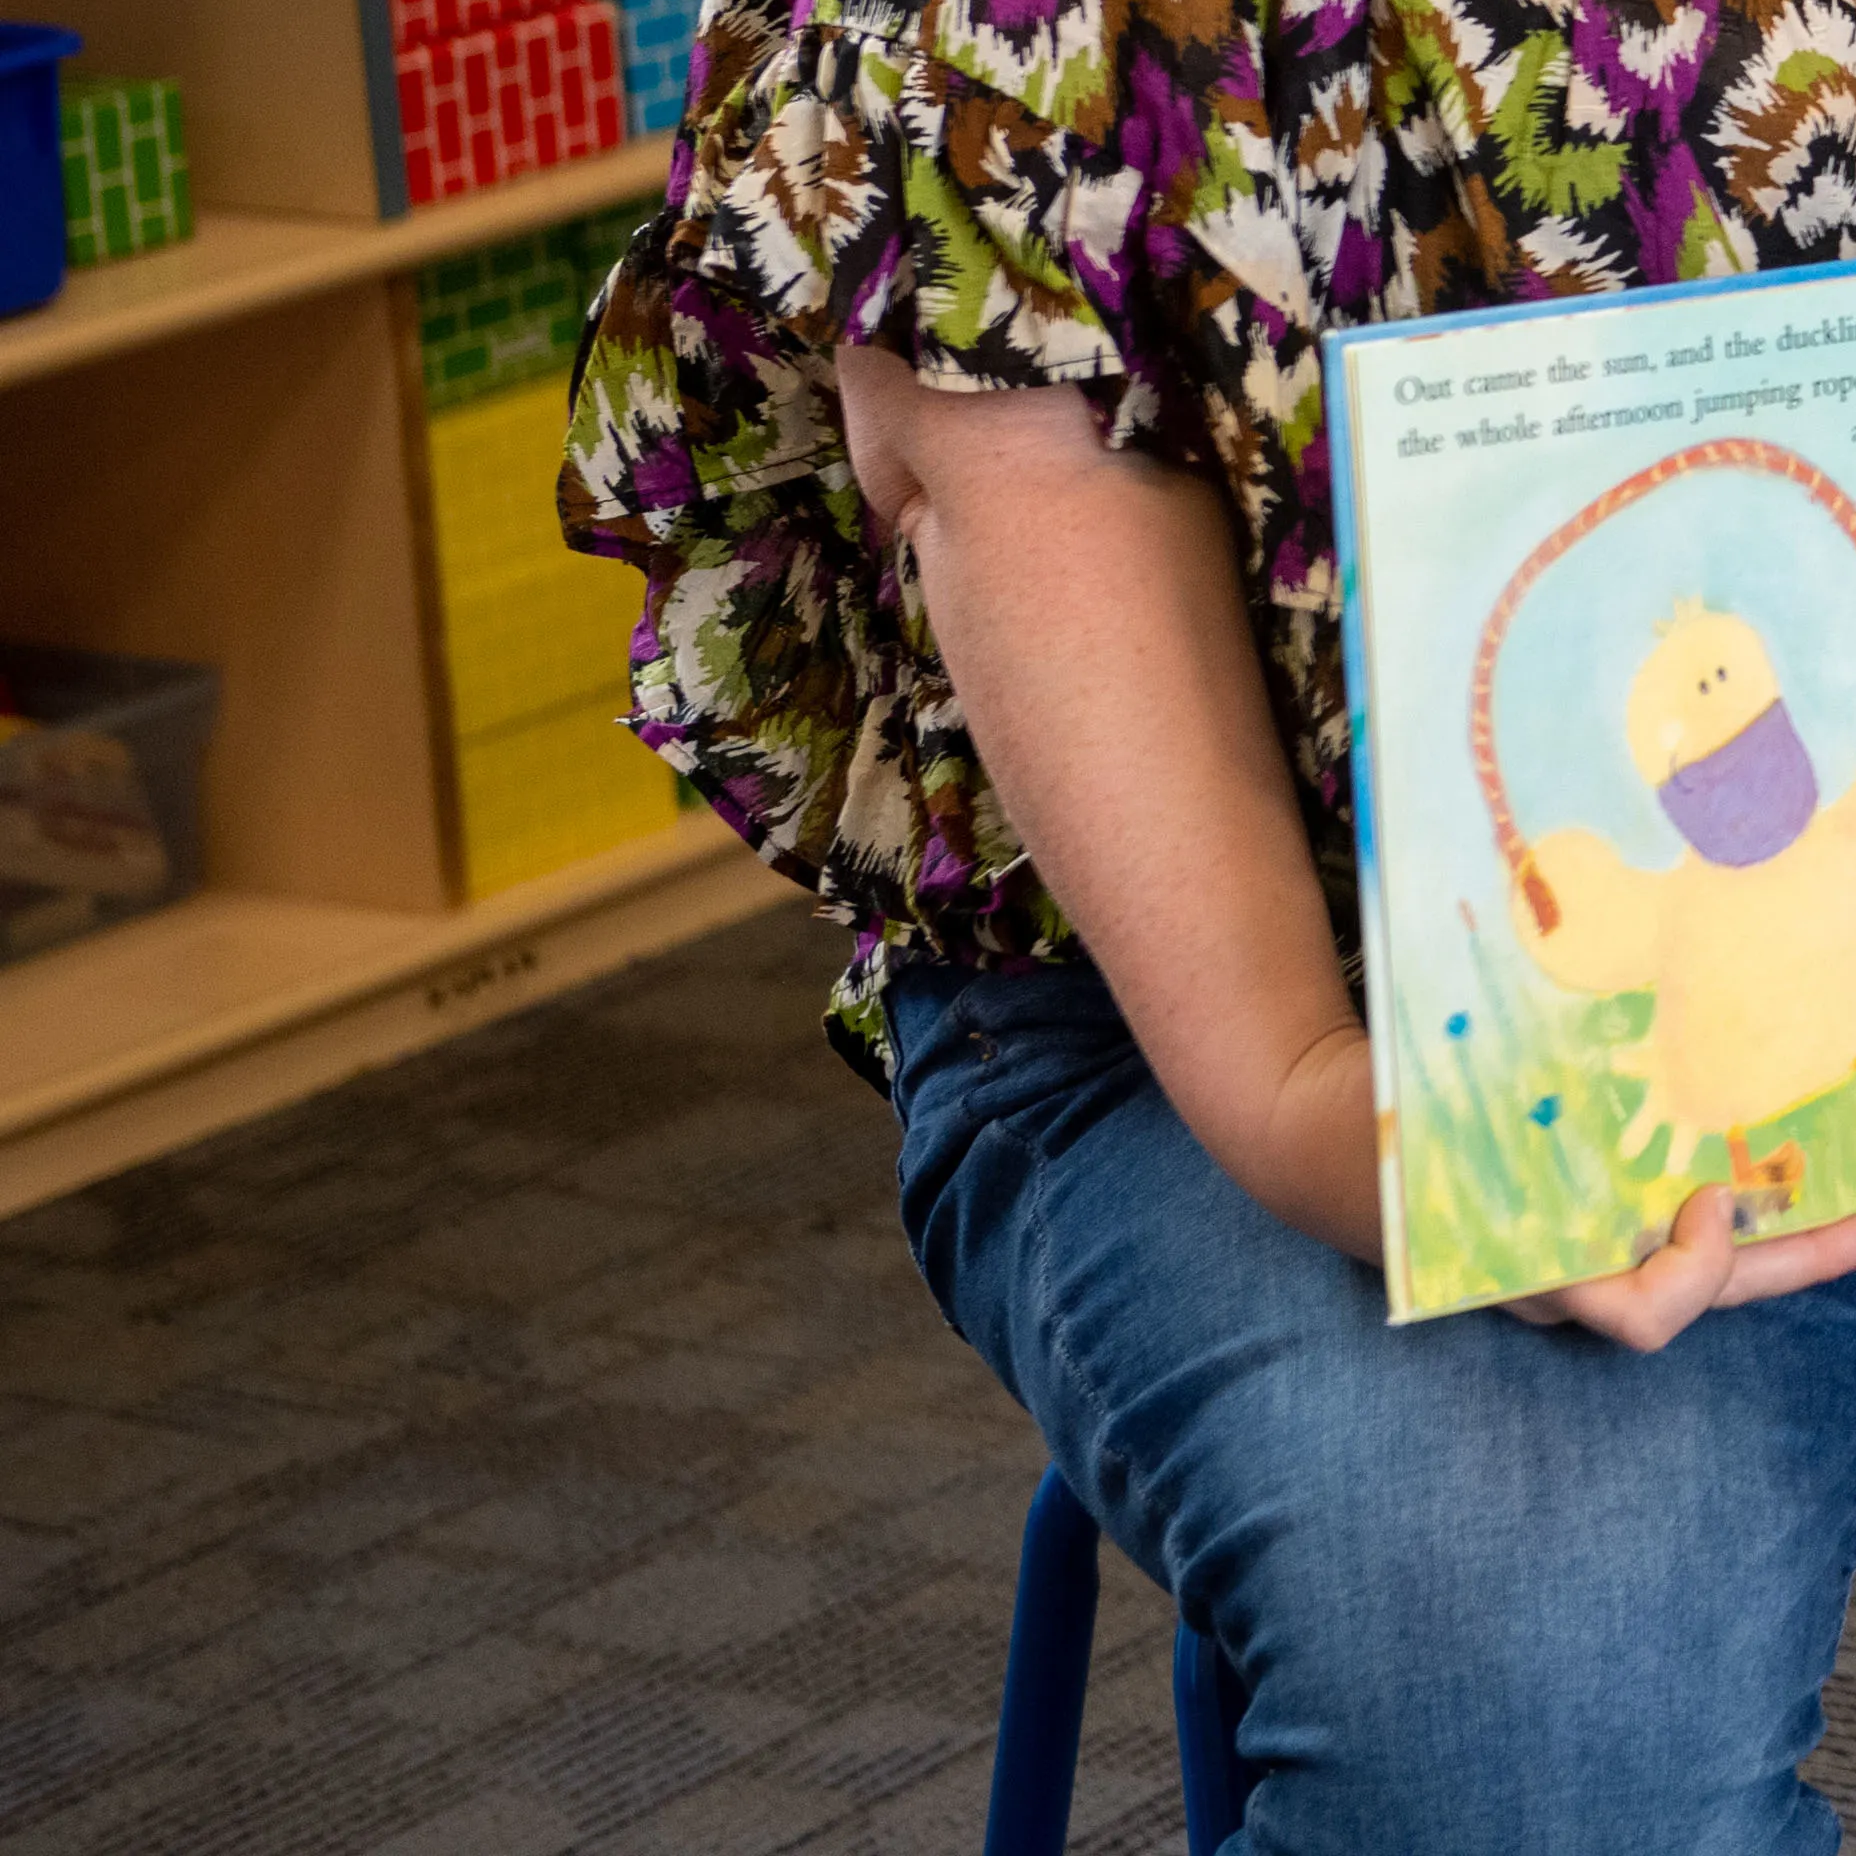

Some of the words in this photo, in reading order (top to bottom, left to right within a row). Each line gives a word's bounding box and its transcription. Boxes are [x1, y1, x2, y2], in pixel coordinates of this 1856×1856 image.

[1394, 377, 1453, 405] Out
[1463, 369, 1537, 396] came
[1547, 355, 1591, 384] the
[1603, 353, 1658, 376] sun,
[1665, 335, 1715, 368] and
[1724, 331, 1766, 360] the
[1397, 428, 1444, 458] the
[1455, 413, 1541, 448] whole
[1552, 400, 1684, 436] afternoon
[1690, 379, 1804, 425] jumping
